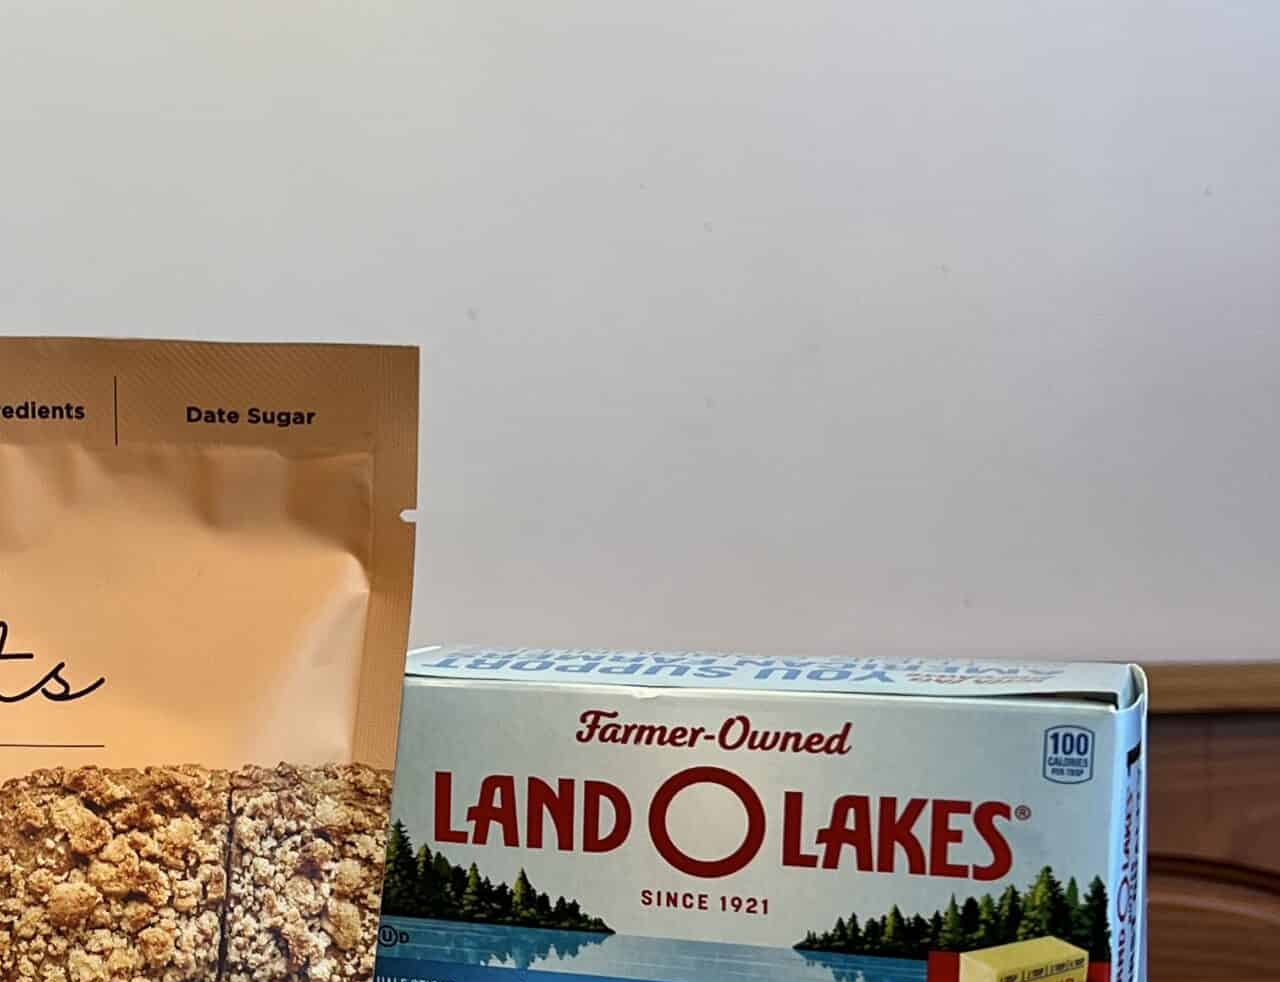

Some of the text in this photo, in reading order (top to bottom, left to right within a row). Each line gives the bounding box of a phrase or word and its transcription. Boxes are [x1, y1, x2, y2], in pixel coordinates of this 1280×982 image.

[186, 406, 316, 429] Date Sugar
[575, 709, 854, 756] Farmer-Owned
[1050, 732, 1089, 756] 100
[433, 770, 633, 853] LAND
[640, 888, 769, 915] SINCE 1921
